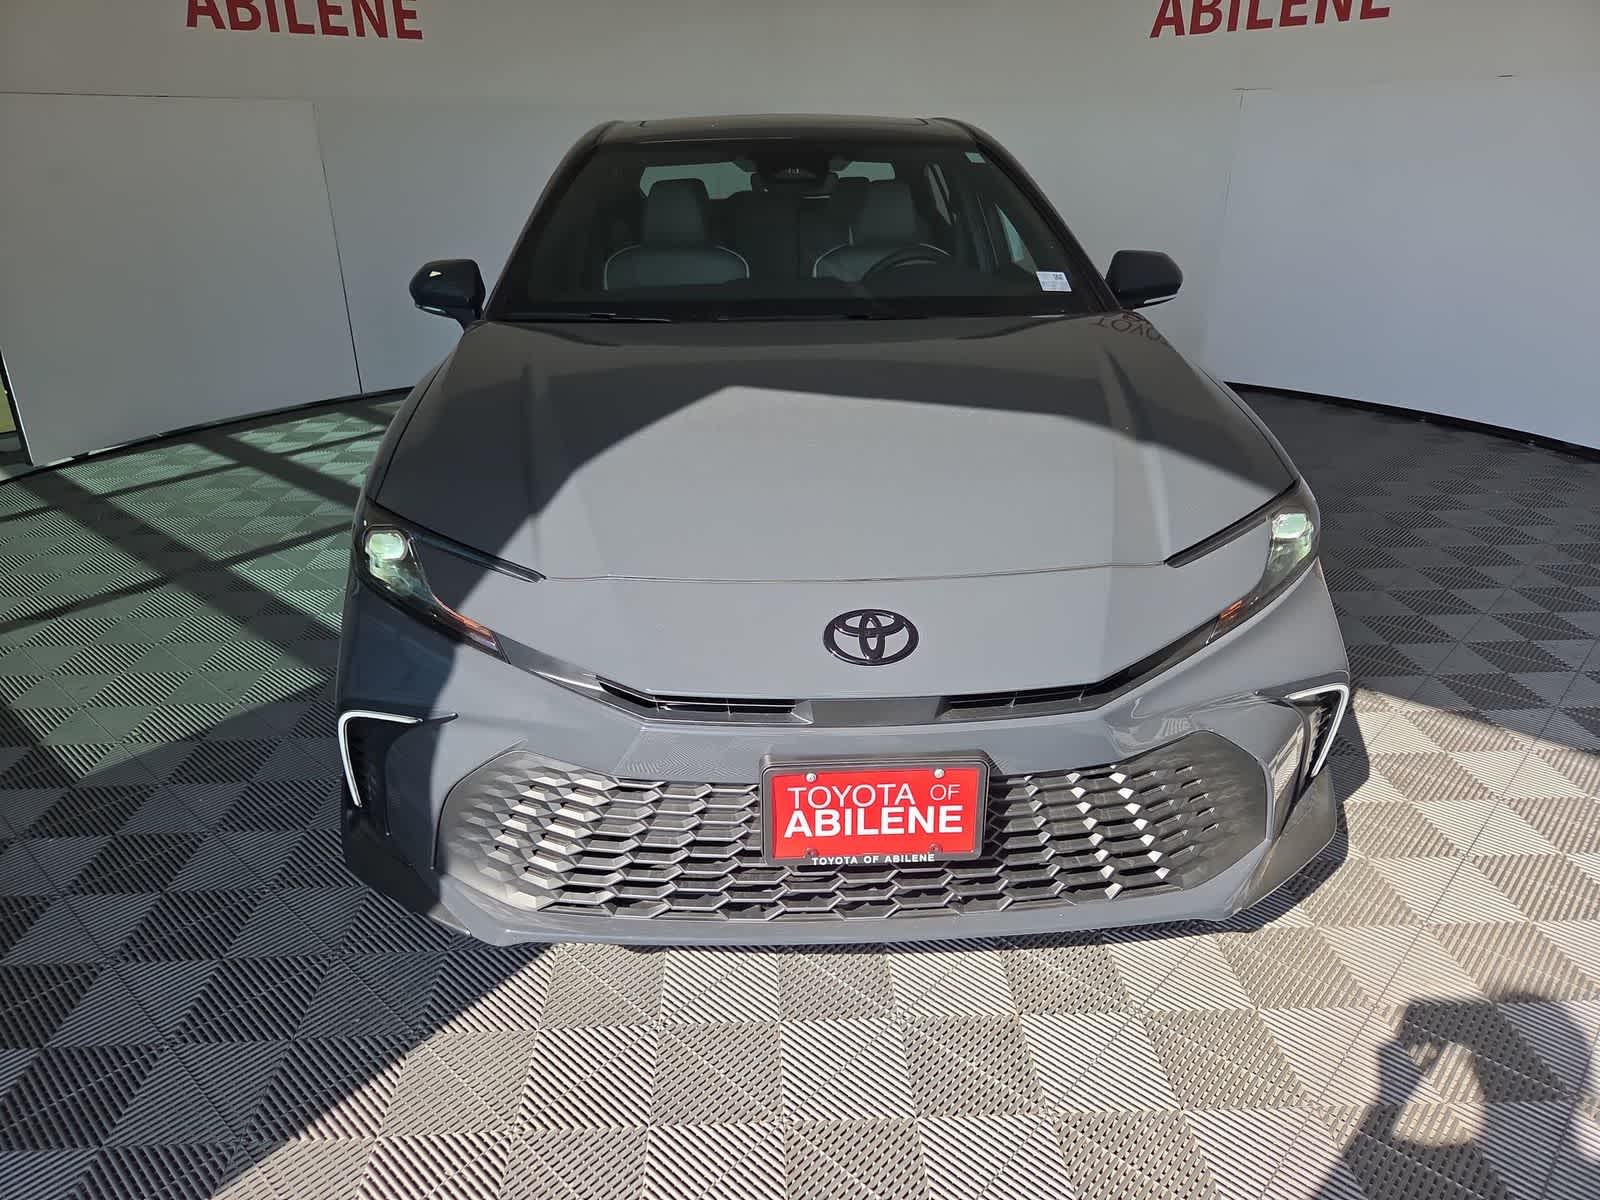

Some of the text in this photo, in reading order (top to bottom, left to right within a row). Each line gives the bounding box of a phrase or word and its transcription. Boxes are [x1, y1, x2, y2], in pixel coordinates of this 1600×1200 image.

[186, 0, 424, 40] ABILENE
[787, 783, 961, 809] TOYOTA OF
[783, 805, 963, 838] ABILENE
[811, 853, 936, 866] TOYOTA OF ABILENE
